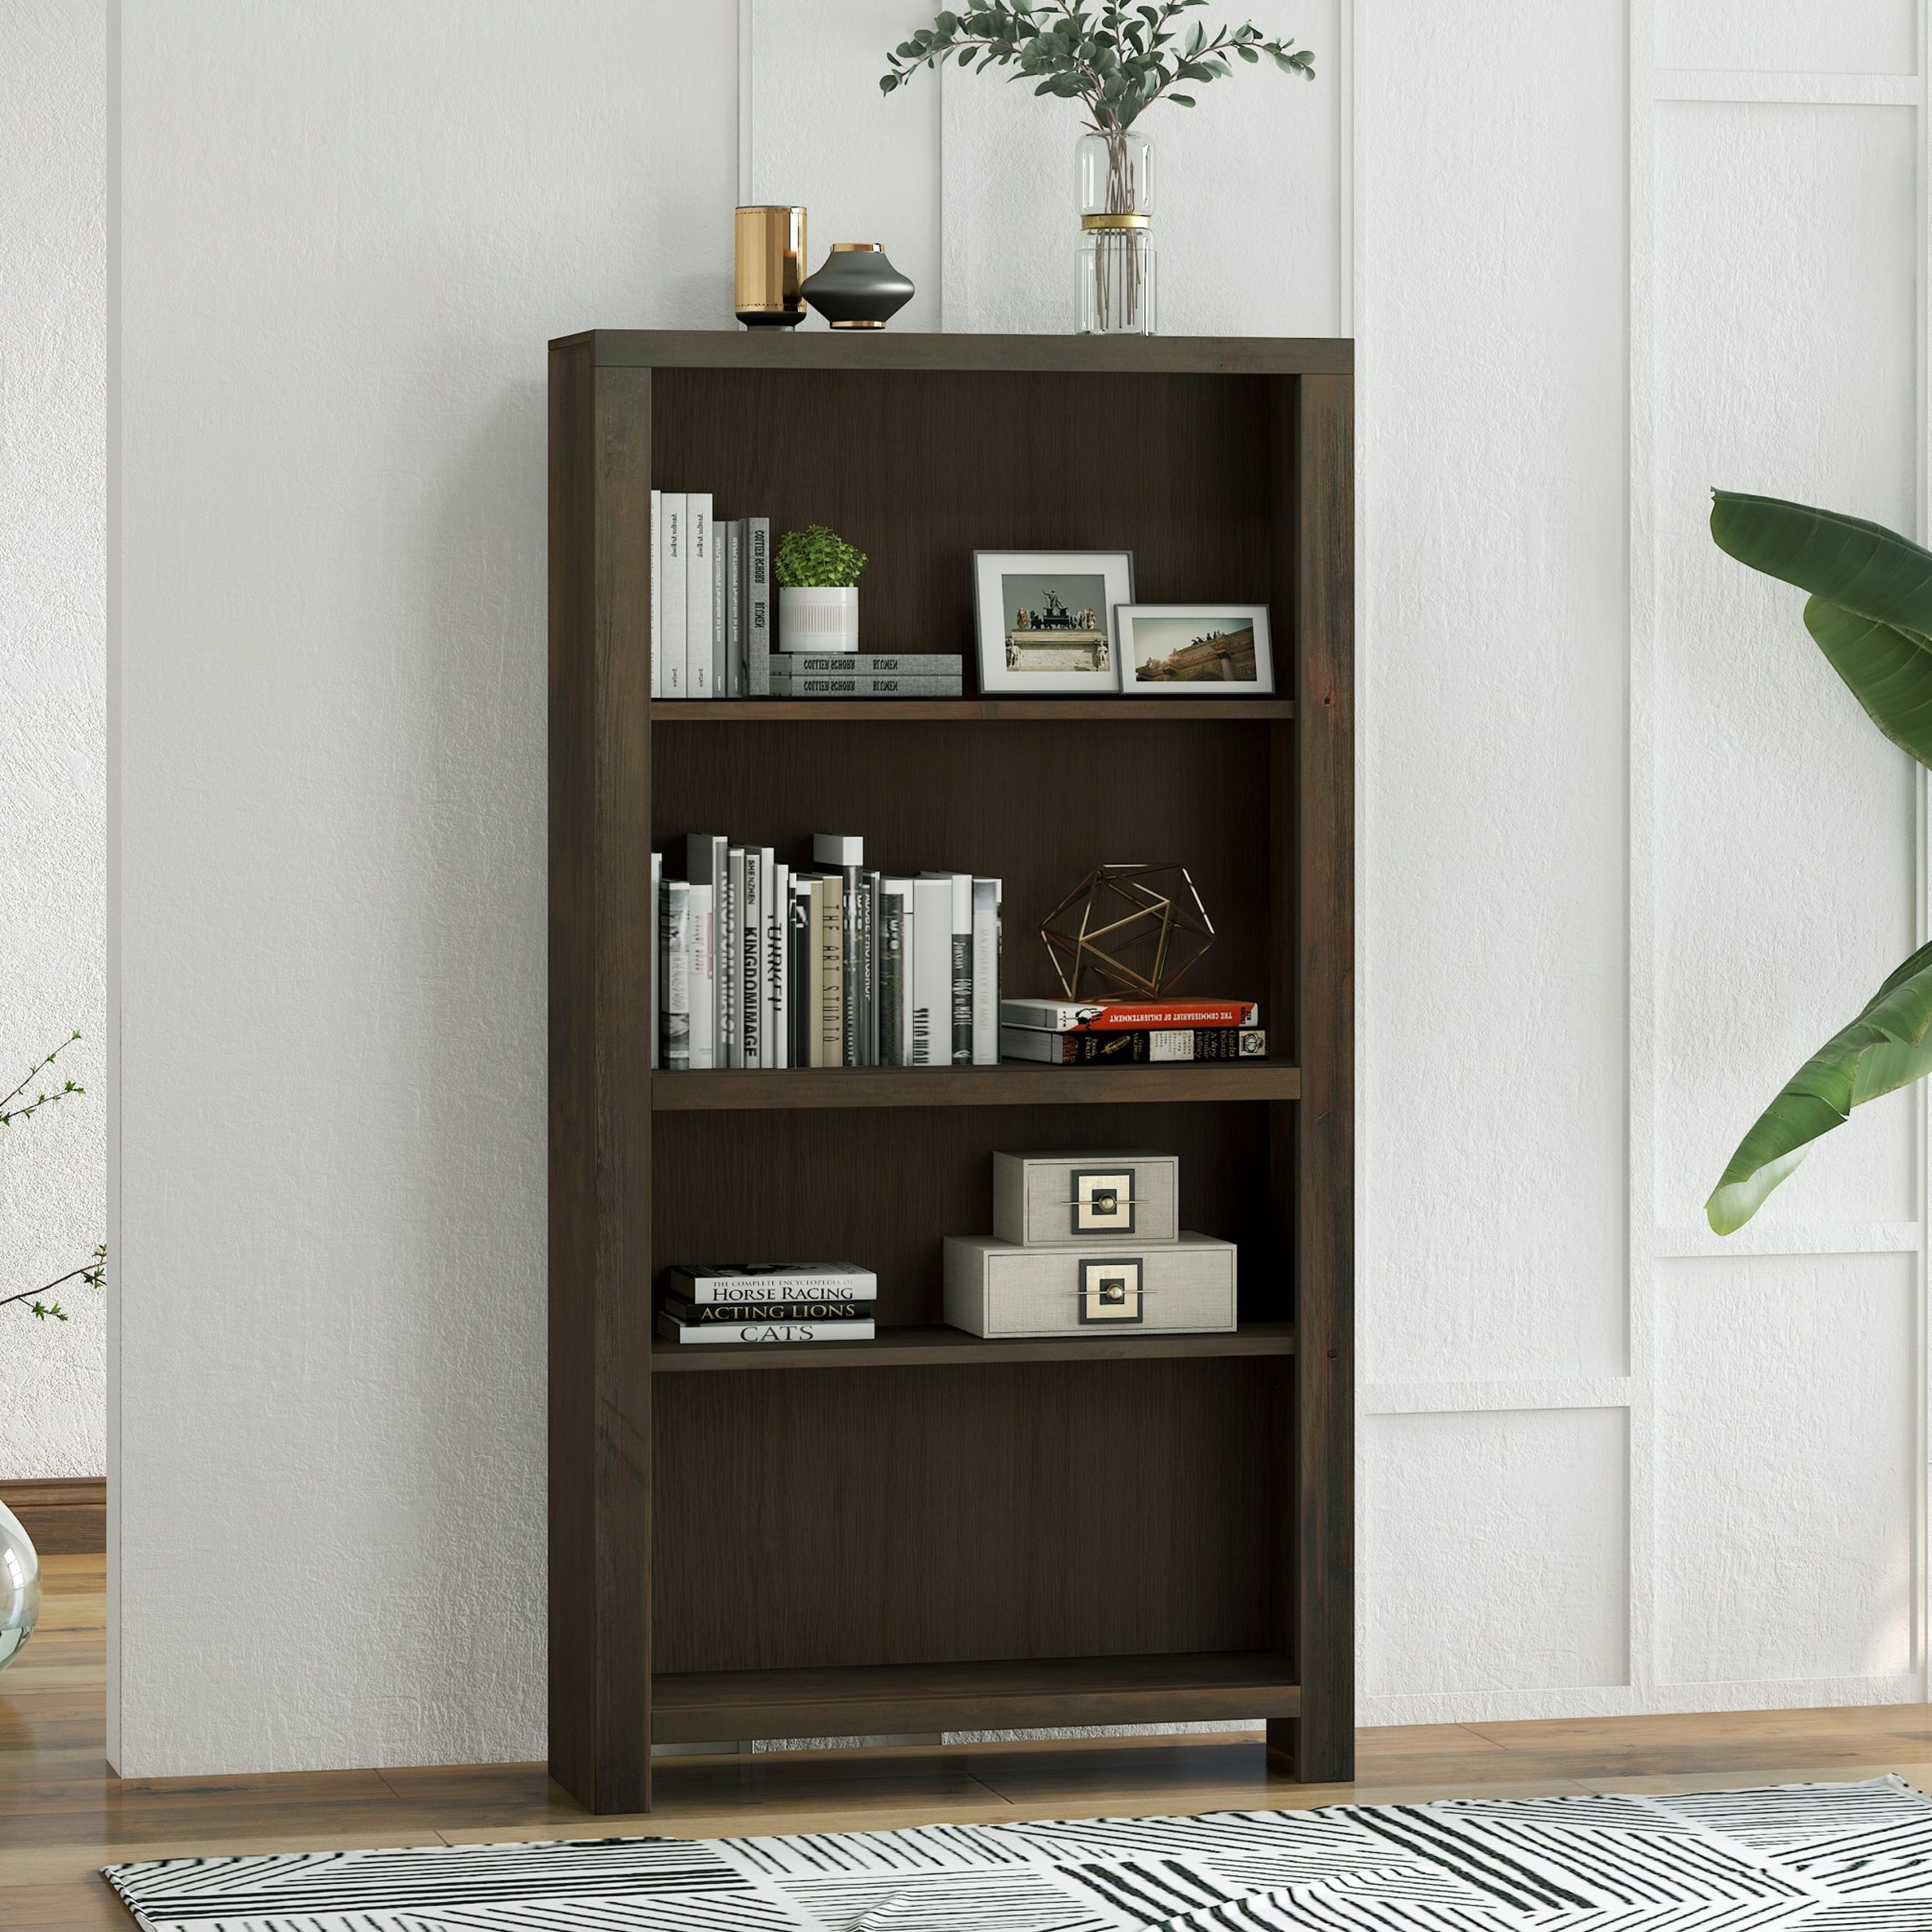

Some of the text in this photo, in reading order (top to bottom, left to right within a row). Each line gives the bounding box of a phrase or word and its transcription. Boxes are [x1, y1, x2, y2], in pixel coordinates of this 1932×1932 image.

[1109, 1014, 1163, 1023] ENLIGHTENMENT
[1173, 1012, 1219, 1021] COMMISSARIAT
[712, 1287, 854, 1301] HORSE RACING
[700, 1303, 855, 1320] ACTING LIONS
[740, 1325, 814, 1342] CATS
